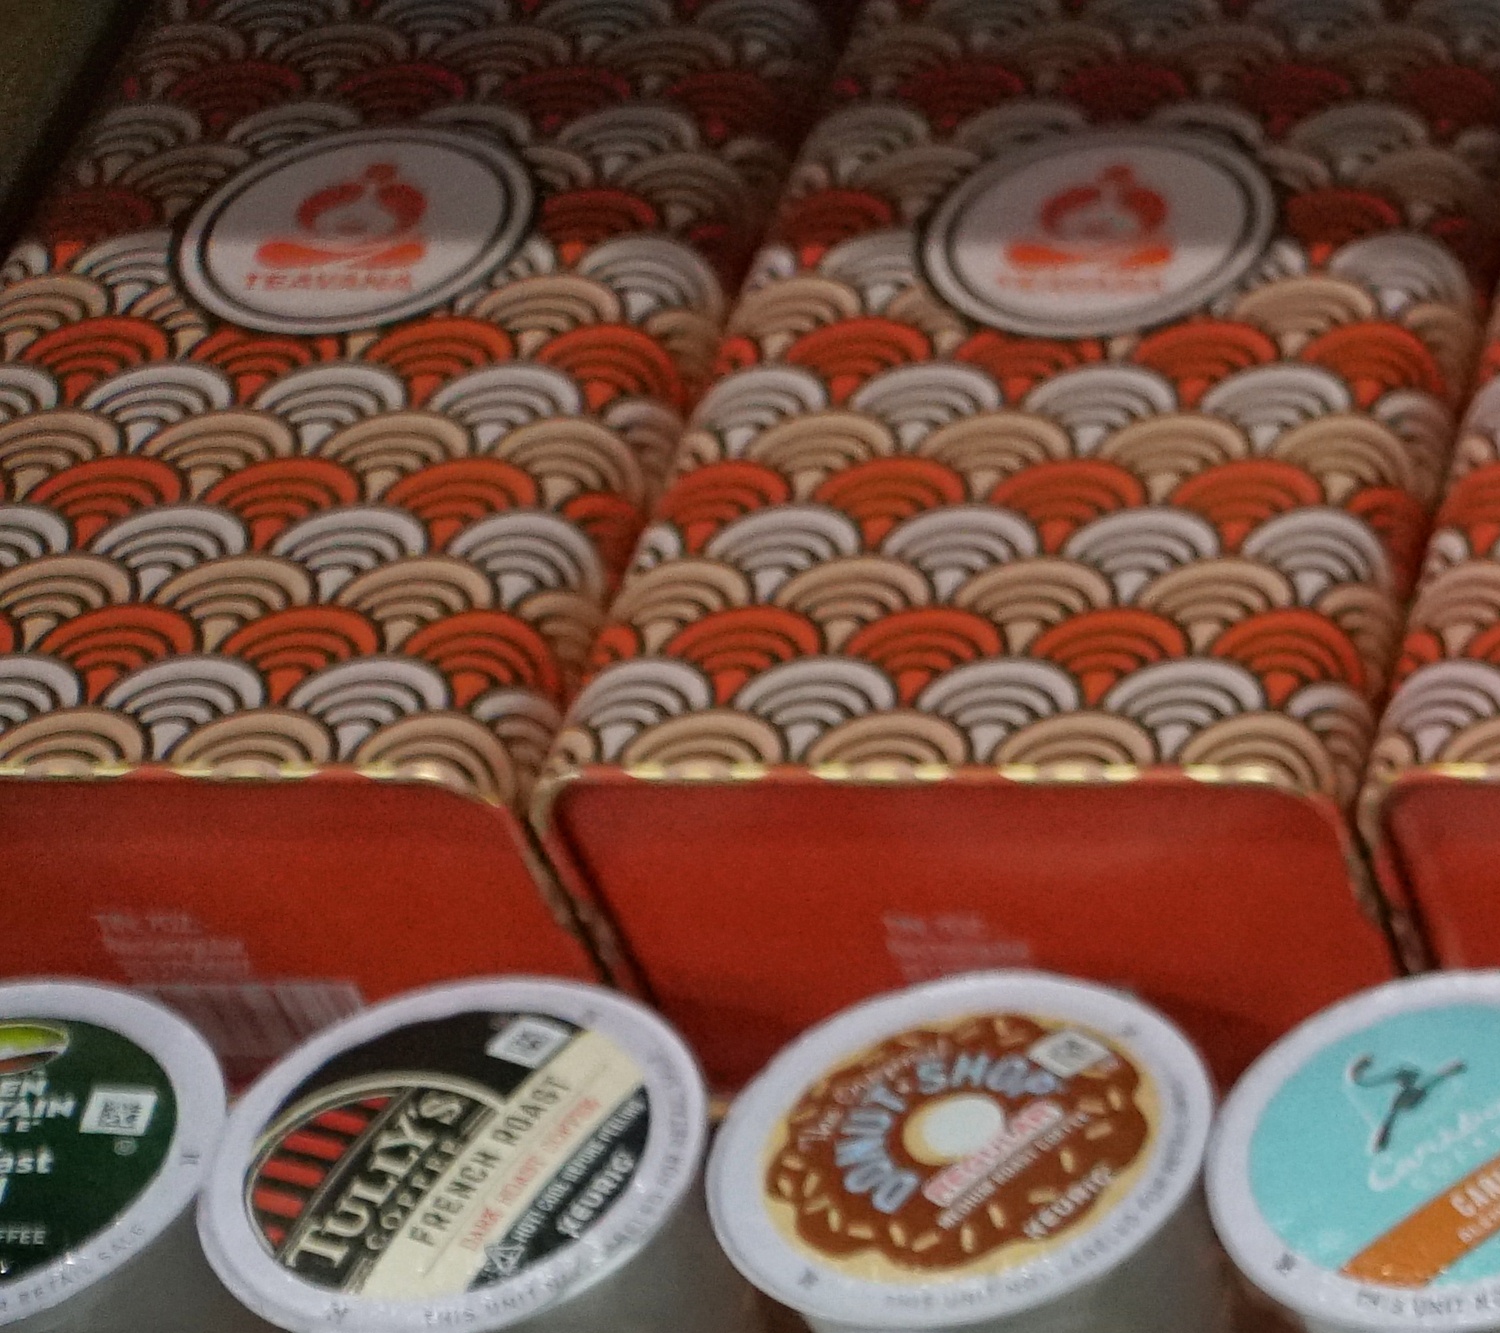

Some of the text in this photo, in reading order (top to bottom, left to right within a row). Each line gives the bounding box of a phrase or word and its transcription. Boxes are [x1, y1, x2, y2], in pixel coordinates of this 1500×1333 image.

[287, 1084, 468, 1270] TULLY'S
[407, 1076, 573, 1248] FRENCH ROAST
